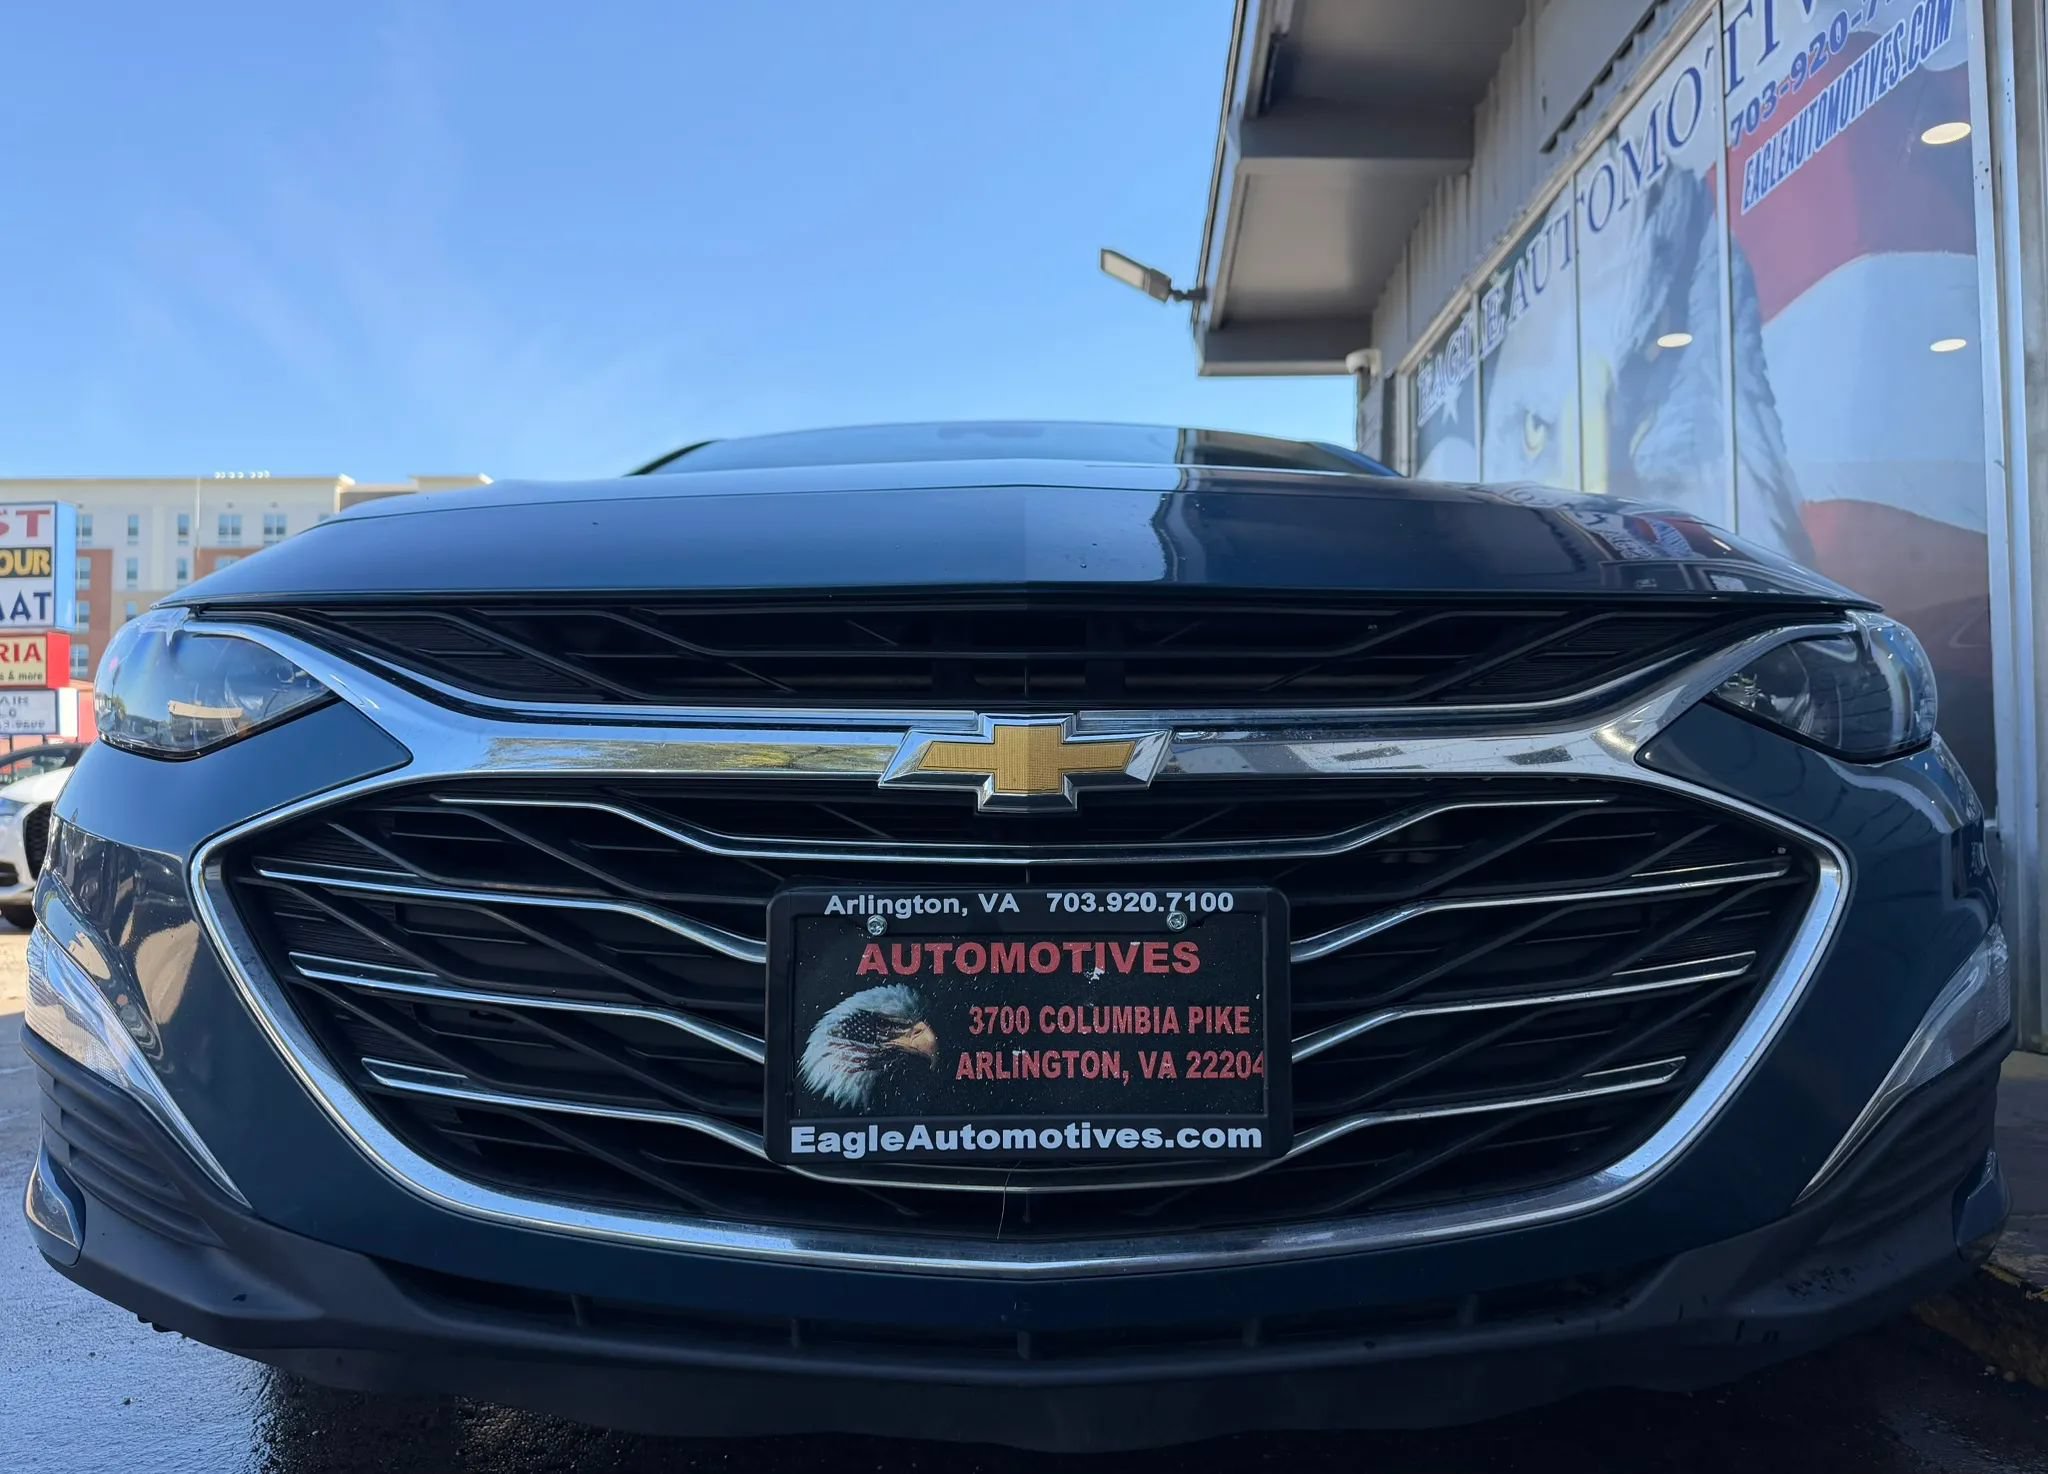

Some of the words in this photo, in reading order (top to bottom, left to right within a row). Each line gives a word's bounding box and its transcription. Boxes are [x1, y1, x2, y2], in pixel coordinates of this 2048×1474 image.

[1742, 0, 1954, 213] EAGLEAUTOMOTIVES.COM
[1509, 0, 1812, 326] AUTOMOTI
[0, 590, 51, 621] AT
[19, 671, 43, 681] more
[824, 894, 968, 919] Arlington,
[978, 893, 1019, 913] VA
[1046, 892, 1234, 913] 703.920.7100
[856, 941, 1200, 976] AUTOMOTIVES
[968, 1006, 1030, 1035] 3700
[1039, 1006, 1180, 1035] COLUMBIA
[1188, 1006, 1250, 1034] PIKE
[955, 1051, 1130, 1085] ARLINGTON,
[1138, 1051, 1178, 1079] VA
[1185, 1050, 1265, 1079] 22204
[791, 1122, 1262, 1159] EagleAutomotives.com
